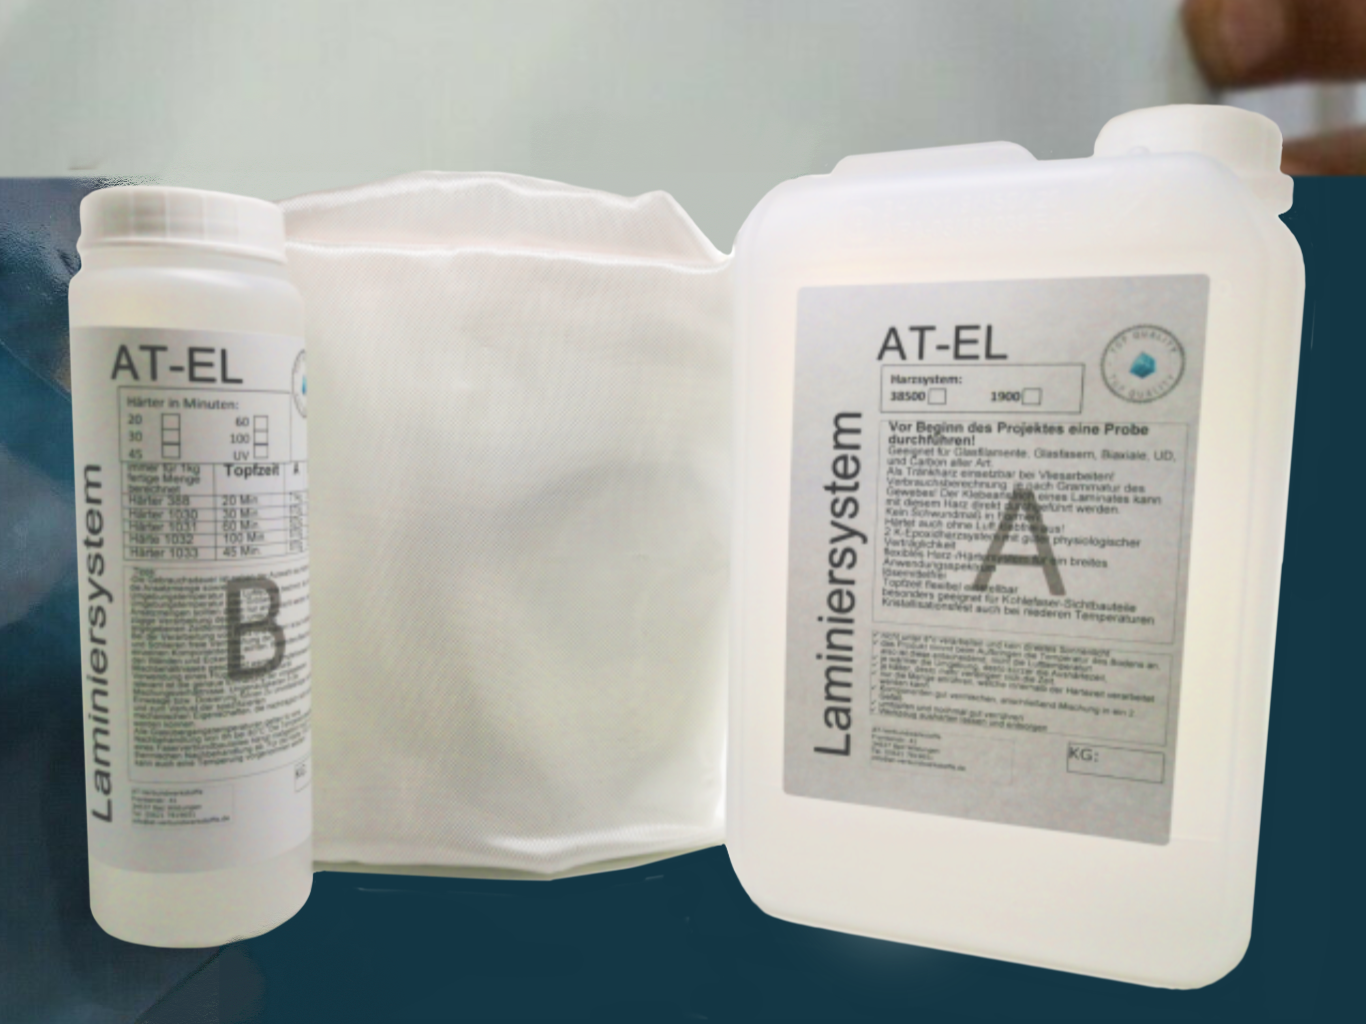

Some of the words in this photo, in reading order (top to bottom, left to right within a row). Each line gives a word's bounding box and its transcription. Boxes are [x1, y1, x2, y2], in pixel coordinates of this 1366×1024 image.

[877, 324, 1008, 361] AT-EL
[111, 344, 243, 384] AT-EL
[890, 374, 962, 386] Harzsystem:
[890, 391, 926, 402] 38500
[991, 391, 1021, 402] 1900
[168, 397, 180, 408] in
[183, 397, 239, 410] Minuten:
[128, 414, 142, 425] 20
[235, 417, 249, 427] 60
[888, 421, 913, 433] Vor
[916, 421, 964, 436] Beginn
[967, 422, 992, 434] des
[997, 422, 1065, 437] Projektes
[1068, 423, 1100, 435] eine
[1104, 423, 1149, 436] Probe
[128, 431, 142, 442] 30
[230, 433, 250, 444] 100
[888, 435, 976, 447] durchführen!
[129, 449, 143, 460] 45
[234, 451, 249, 461] UV
[887, 457, 906, 466] und
[222, 463, 280, 480] Topfzeit
[971, 483, 1066, 597] A
[813, 412, 868, 757] Laminiersystem
[225, 576, 287, 683] B
[82, 464, 114, 823] Laminiersystem
[1068, 746, 1099, 763] KG:
